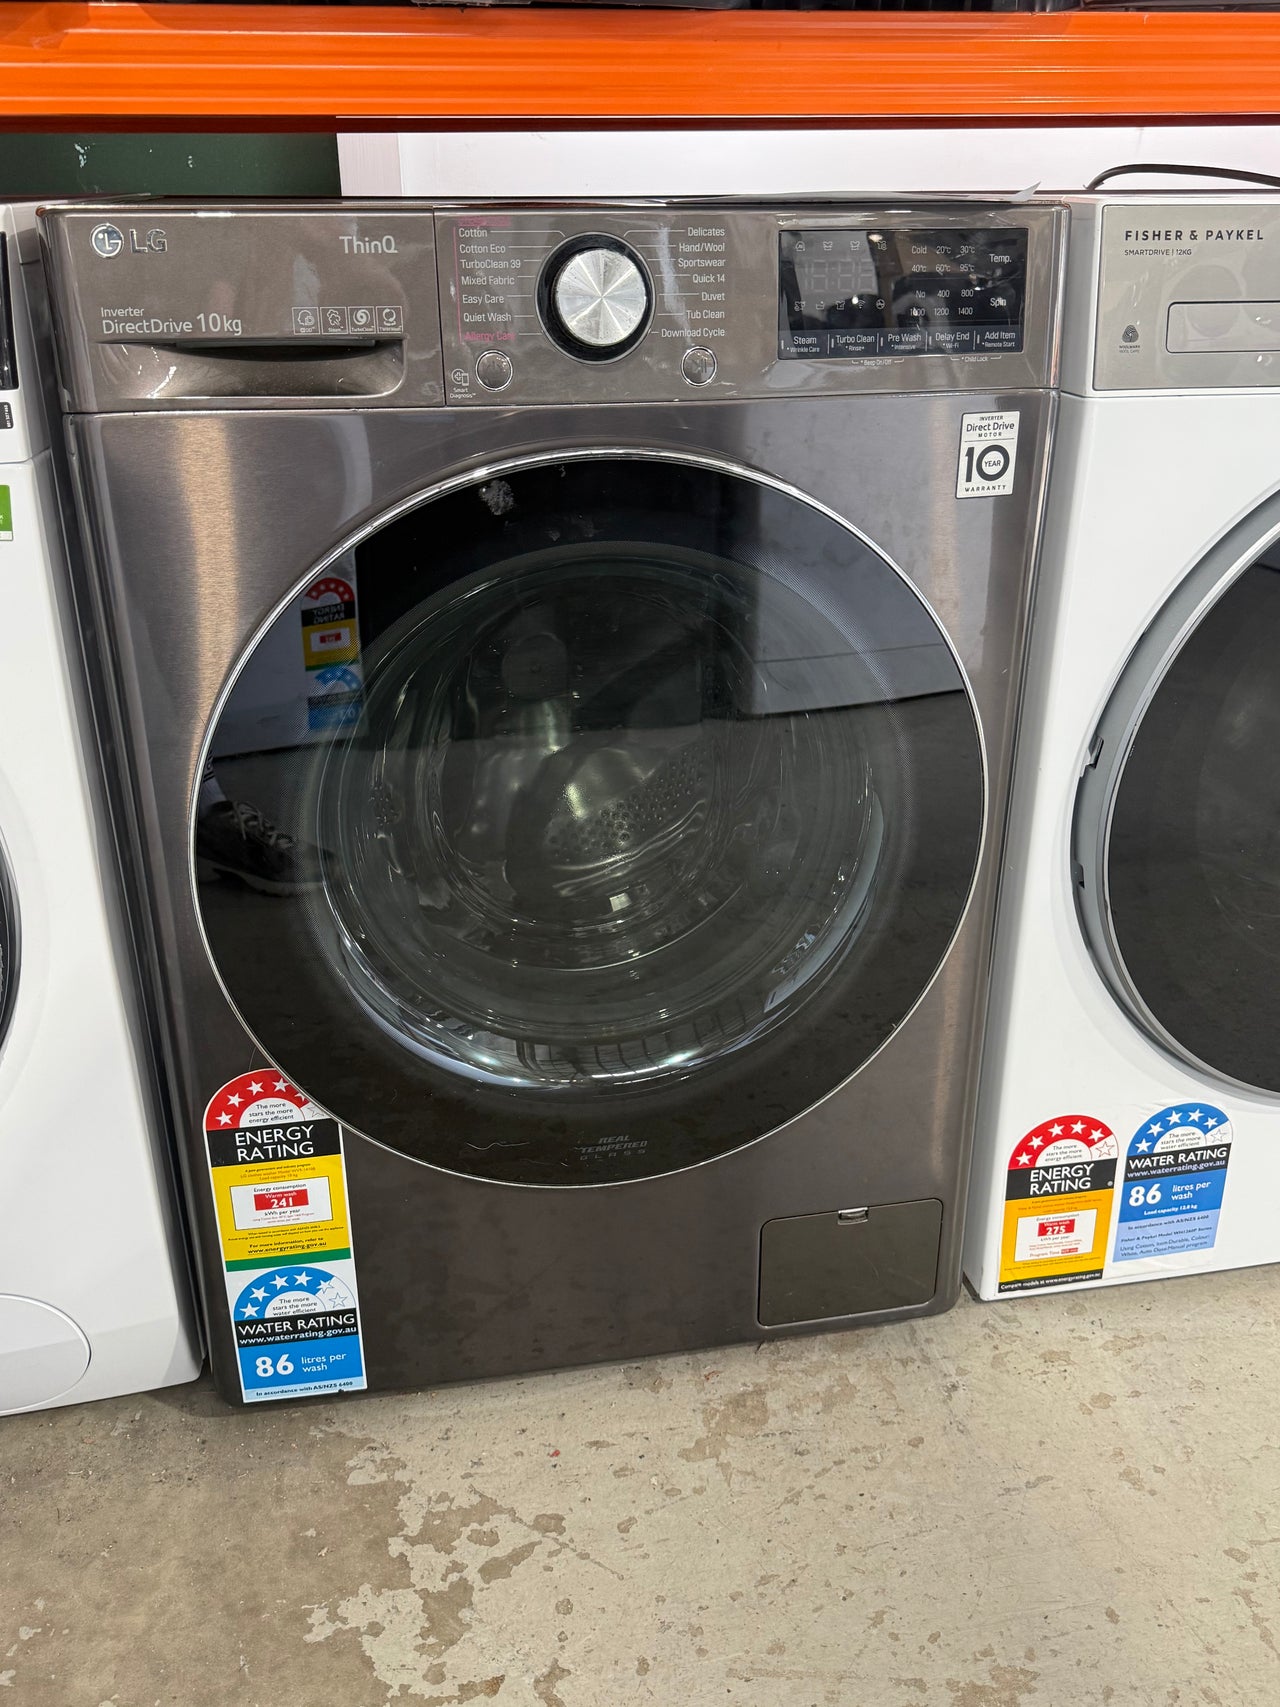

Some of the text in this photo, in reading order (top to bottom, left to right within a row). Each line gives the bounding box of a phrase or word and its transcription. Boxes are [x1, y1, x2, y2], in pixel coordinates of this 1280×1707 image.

[459, 228, 487, 238] Cotton
[687, 227, 725, 236] Delicates
[1125, 230, 1264, 240] FISHER & PAYKEL
[129, 228, 168, 253] LG
[339, 236, 398, 254] ThinQ
[460, 244, 506, 253] Cotton Eco
[679, 243, 725, 252] Hand/Wool
[912, 246, 927, 254] Cold
[460, 260, 521, 268] TurboClean 39
[678, 258, 725, 268] Sportswear
[989, 254, 1012, 264] Temp.
[461, 276, 515, 285] Mixed Fabric
[692, 274, 725, 283] Quick 14
[702, 292, 725, 301] Duvet
[916, 289, 973, 298] No 400 800
[462, 295, 504, 305] Easy Care
[990, 298, 1006, 308] Spin
[101, 307, 144, 318] Inverter
[687, 310, 725, 319] Tub Clean
[934, 308, 949, 316] 1200
[958, 307, 973, 315] 1400
[463, 312, 511, 322] Quiet Wash
[102, 312, 242, 335] DirectDrive 10kg
[661, 328, 725, 338] Download Cycle
[888, 333, 921, 342] Pre Wash
[936, 332, 969, 341] Delay End
[794, 336, 816, 345] Steam
[836, 334, 874, 344] Turbo Clean
[966, 422, 1014, 432] Direct Drive
[965, 444, 1010, 482] 10
[234, 1124, 314, 1146] ENERGY
[599, 1136, 630, 1144] REAL
[237, 1142, 314, 1162] RATING
[1129, 1147, 1227, 1169] WATER RATING
[1031, 1163, 1094, 1182] ENERGY
[1127, 1160, 1225, 1178] www.waterrating.gov.au
[273, 1183, 306, 1191] consumption
[1030, 1178, 1091, 1195] RATING
[1129, 1181, 1211, 1207] 86 litres per
[1172, 1192, 1192, 1201] wash
[271, 1197, 293, 1208] 241
[1046, 1226, 1065, 1235] 275
[238, 1314, 355, 1336] WATER RATING
[239, 1327, 357, 1344] www.waterrating.gov.au
[255, 1353, 347, 1377] 86 litres per
[302, 1364, 328, 1373] wash
